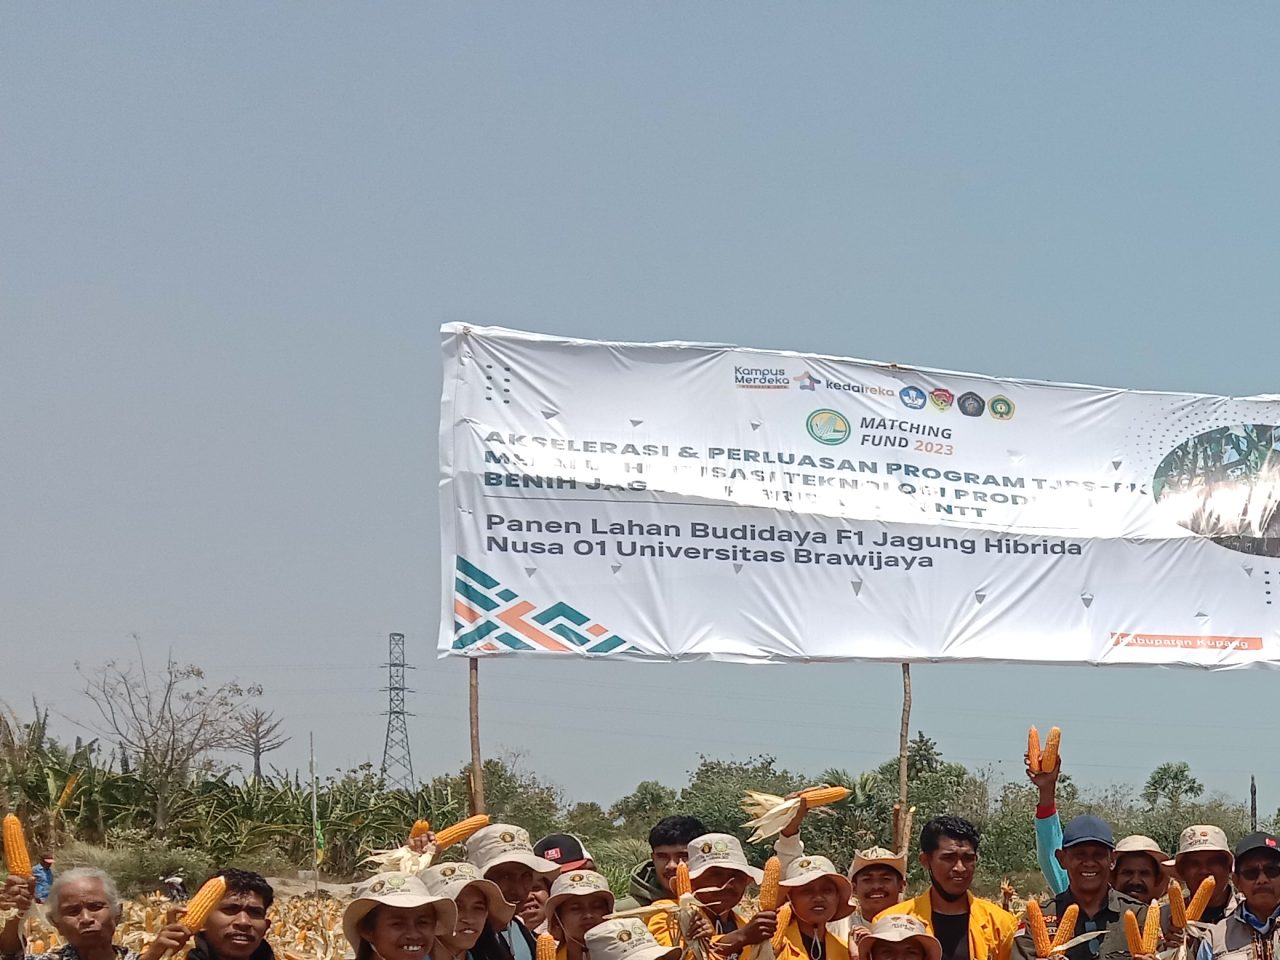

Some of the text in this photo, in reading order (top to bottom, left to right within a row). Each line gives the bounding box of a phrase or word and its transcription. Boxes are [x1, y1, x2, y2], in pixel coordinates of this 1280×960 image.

[735, 366, 785, 377] Kampus
[735, 375, 790, 384] Merdeka
[826, 379, 895, 398] kedaireka
[860, 417, 953, 440] MATCHING
[860, 434, 954, 456] FUND 2023
[484, 431, 670, 457] AKSELERASI
[678, 446, 700, 459] &
[708, 447, 878, 474] PERLUASAN
[886, 462, 1026, 489] PROGRAM
[484, 471, 577, 490] BENIH
[486, 514, 1083, 556] Panen Lahan Budidaya F1 Jagung Hibrida
[486, 536, 564, 555] Nusa
[616, 540, 785, 564] Universitas
[794, 549, 934, 571] Brawijaya
